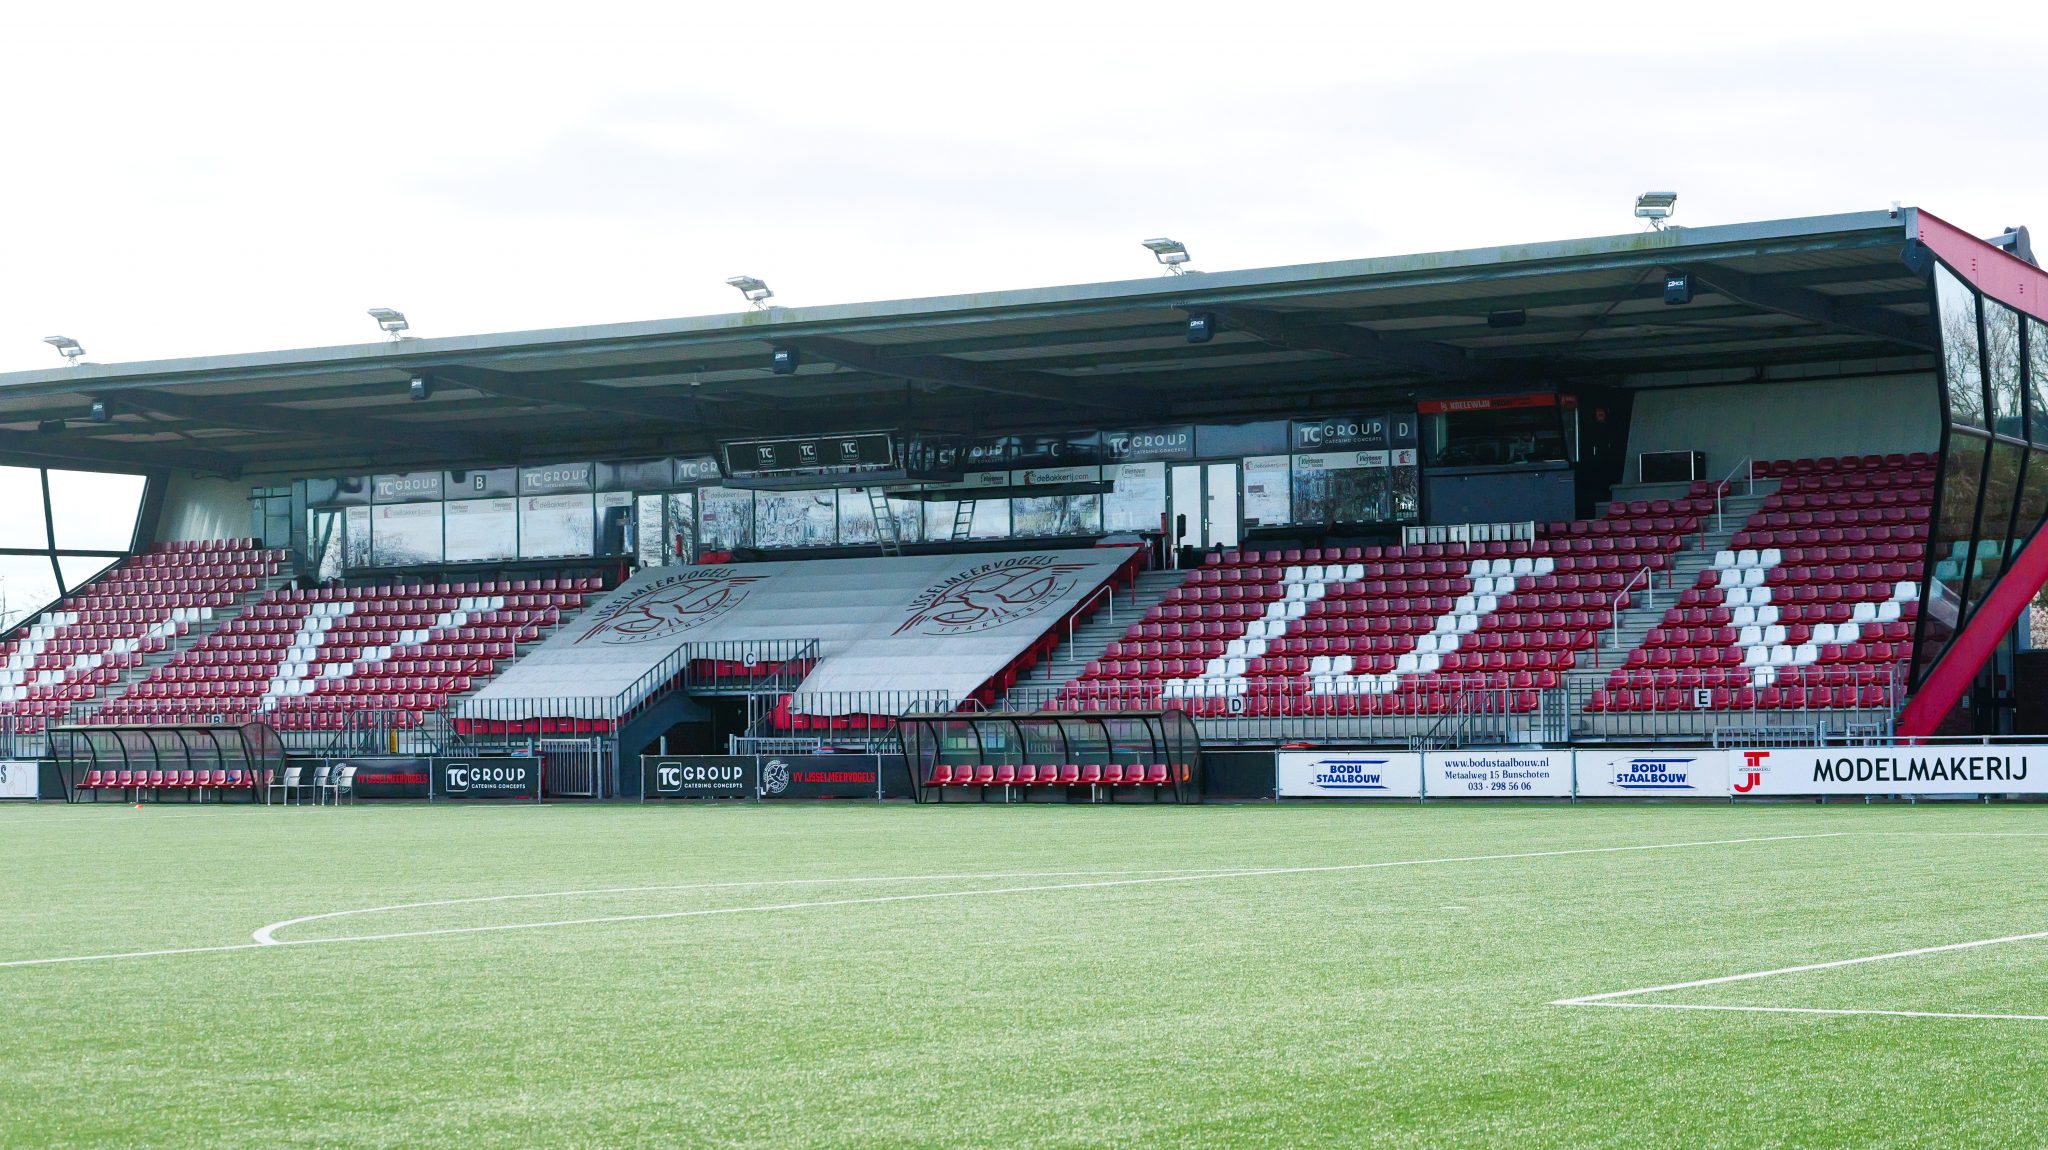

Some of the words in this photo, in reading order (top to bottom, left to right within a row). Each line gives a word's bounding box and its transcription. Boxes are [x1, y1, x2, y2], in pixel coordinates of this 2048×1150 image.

[1300, 426, 1321, 443] TC
[1324, 421, 1382, 437] GROUP
[1399, 422, 1409, 437] D
[842, 442, 857, 454] TC
[1110, 438, 1129, 453] TC
[1132, 433, 1187, 448] GROUP
[759, 447, 774, 459] TC
[801, 445, 815, 456] TC
[1051, 443, 1059, 457] C
[680, 463, 697, 478] TC
[476, 476, 484, 490] B
[524, 473, 541, 487] TC
[543, 470, 589, 482] GROUP
[378, 481, 394, 496] TC
[395, 478, 438, 491] GROUP
[906, 555, 1059, 612] IJSSELMEERVOGELS
[592, 568, 737, 621] IJSSELMEERVOGELS
[746, 653, 754, 665] C
[1699, 691, 1708, 704] E
[1232, 699, 1241, 711] D
[1445, 757, 1549, 768] www.bodustaalbouw.nl
[1631, 763, 1666, 773] BODU
[1330, 765, 1362, 774] BODU
[1445, 771, 1487, 780] Metaalweg
[1490, 771, 1500, 779] 15
[1502, 770, 1550, 778] Bunschoten
[1813, 756, 2028, 782] MODELMAKERIJ
[356, 773, 365, 784] VV
[447, 768, 468, 787] TC
[470, 767, 526, 781] GROUP
[659, 767, 680, 786] TC
[683, 766, 743, 780] GROUP
[793, 772, 802, 783] VV
[804, 771, 876, 783] IJSSELMEERVOGELS
[1316, 774, 1380, 783] STAALBOUW
[1616, 774, 1686, 782] STAALBOUW
[1468, 782, 1483, 790] 033
[1491, 782, 1506, 790] 298
[1508, 782, 1519, 790] 56
[1521, 782, 1532, 790] 06
